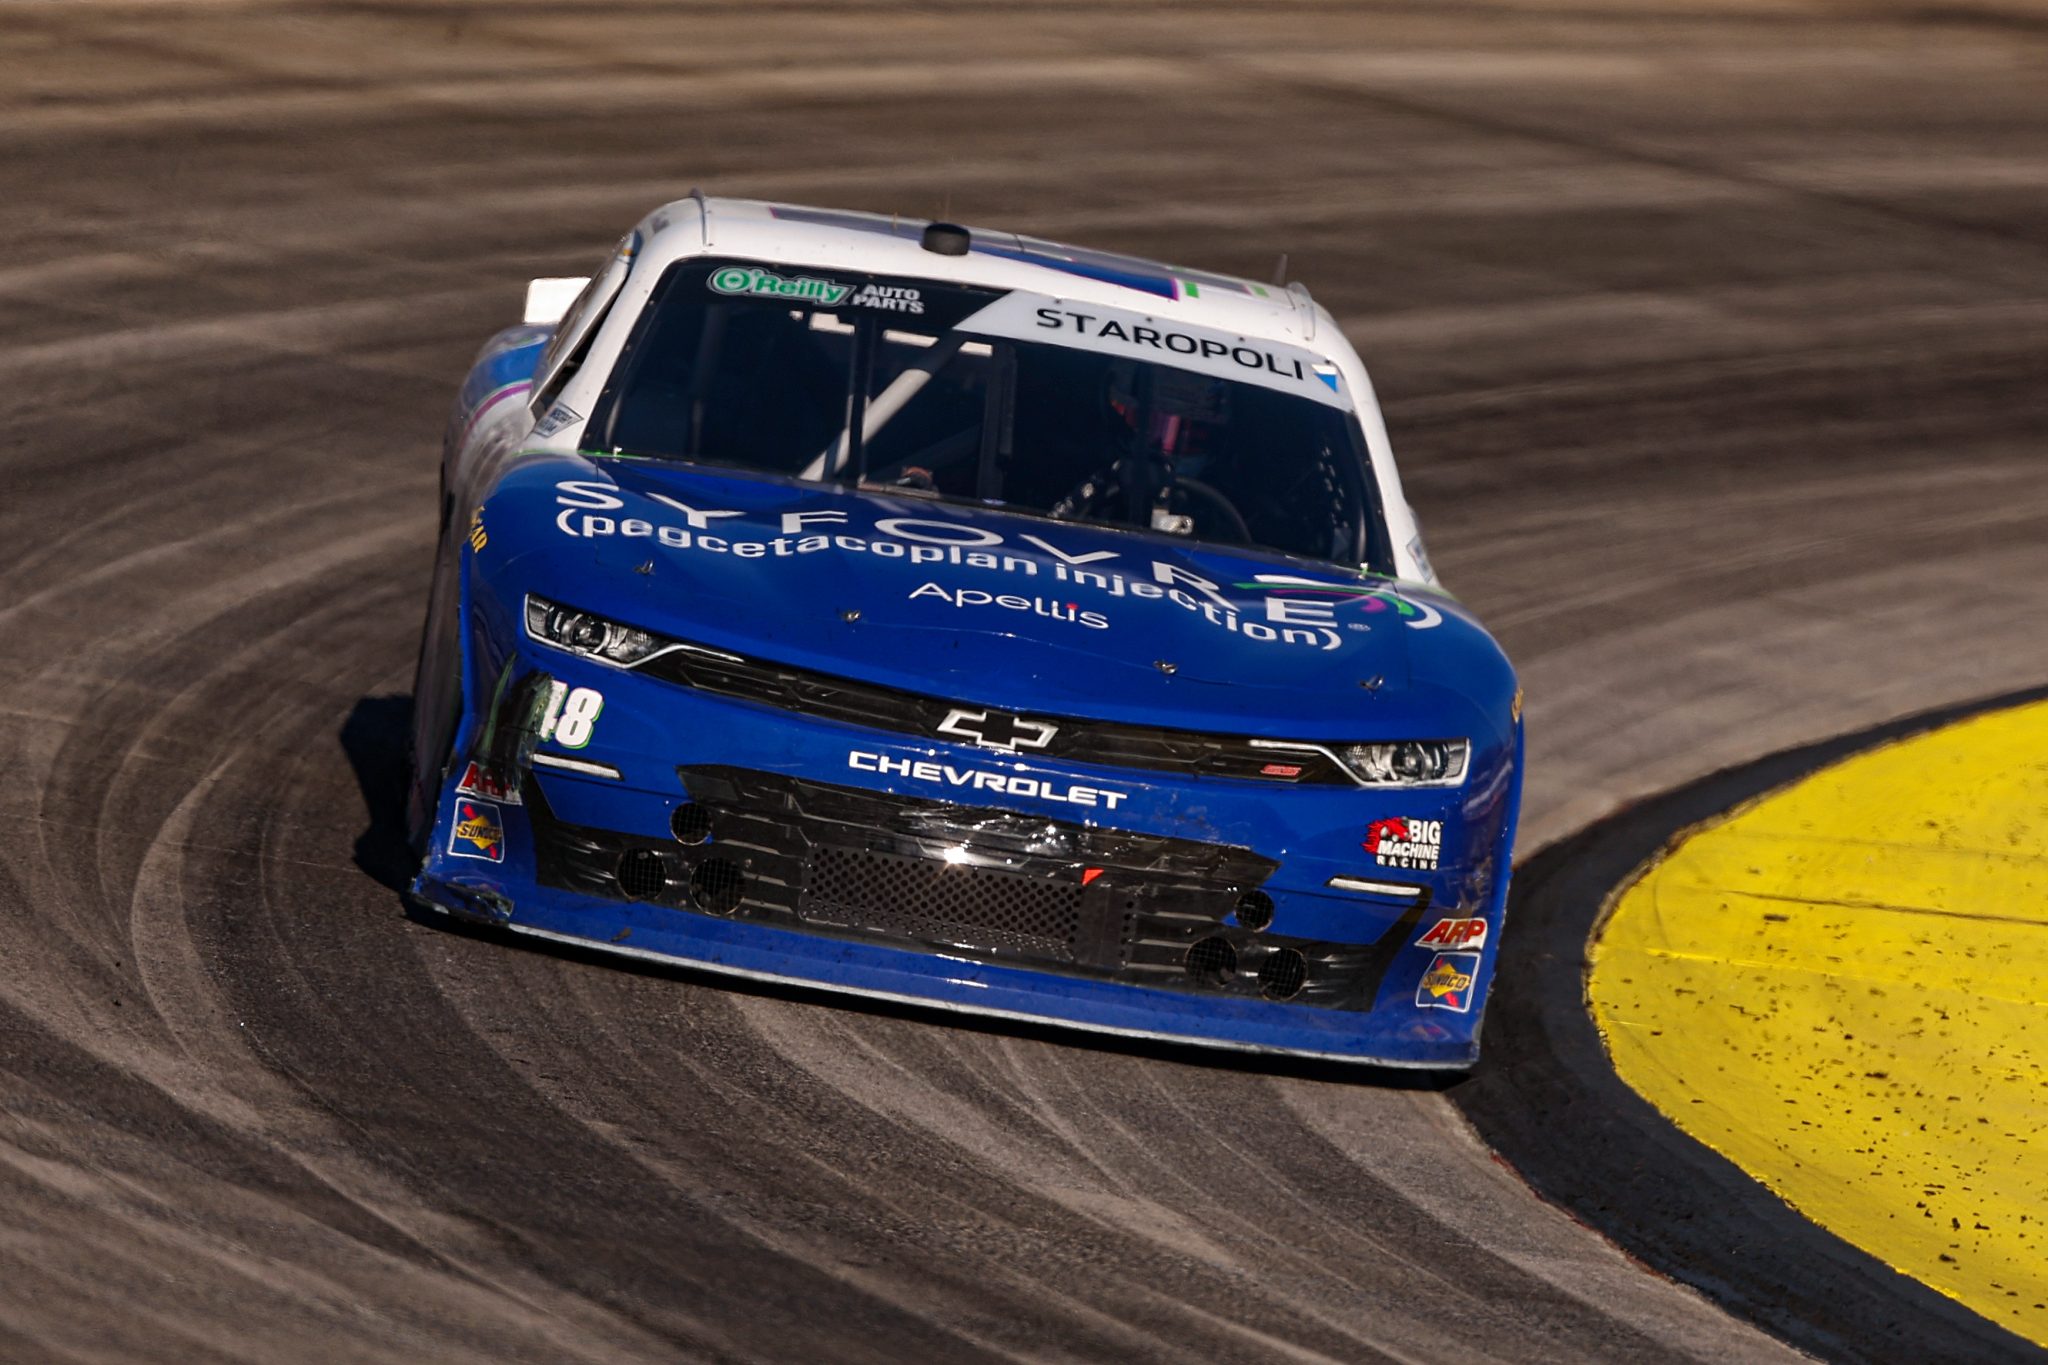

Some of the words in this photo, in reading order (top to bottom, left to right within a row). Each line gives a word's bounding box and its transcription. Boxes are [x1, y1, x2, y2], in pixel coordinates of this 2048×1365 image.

[711, 266, 849, 304] O'Reilly
[862, 284, 920, 300] AUTO
[852, 294, 925, 314] PARTS
[1035, 307, 1304, 381] STAROPOLI
[555, 480, 1339, 628] SYFOVRE
[556, 507, 1037, 575] (pegcetacoplan
[1055, 561, 1343, 650] injection)
[908, 581, 1109, 629] Apellis
[848, 750, 1128, 810] CHEVROLET
[1408, 819, 1441, 844] BIG
[1377, 839, 1440, 860] MACHINE
[1376, 855, 1437, 870] RACING
[1422, 919, 1485, 944] ARP
[1423, 972, 1469, 989] SUNOCO
